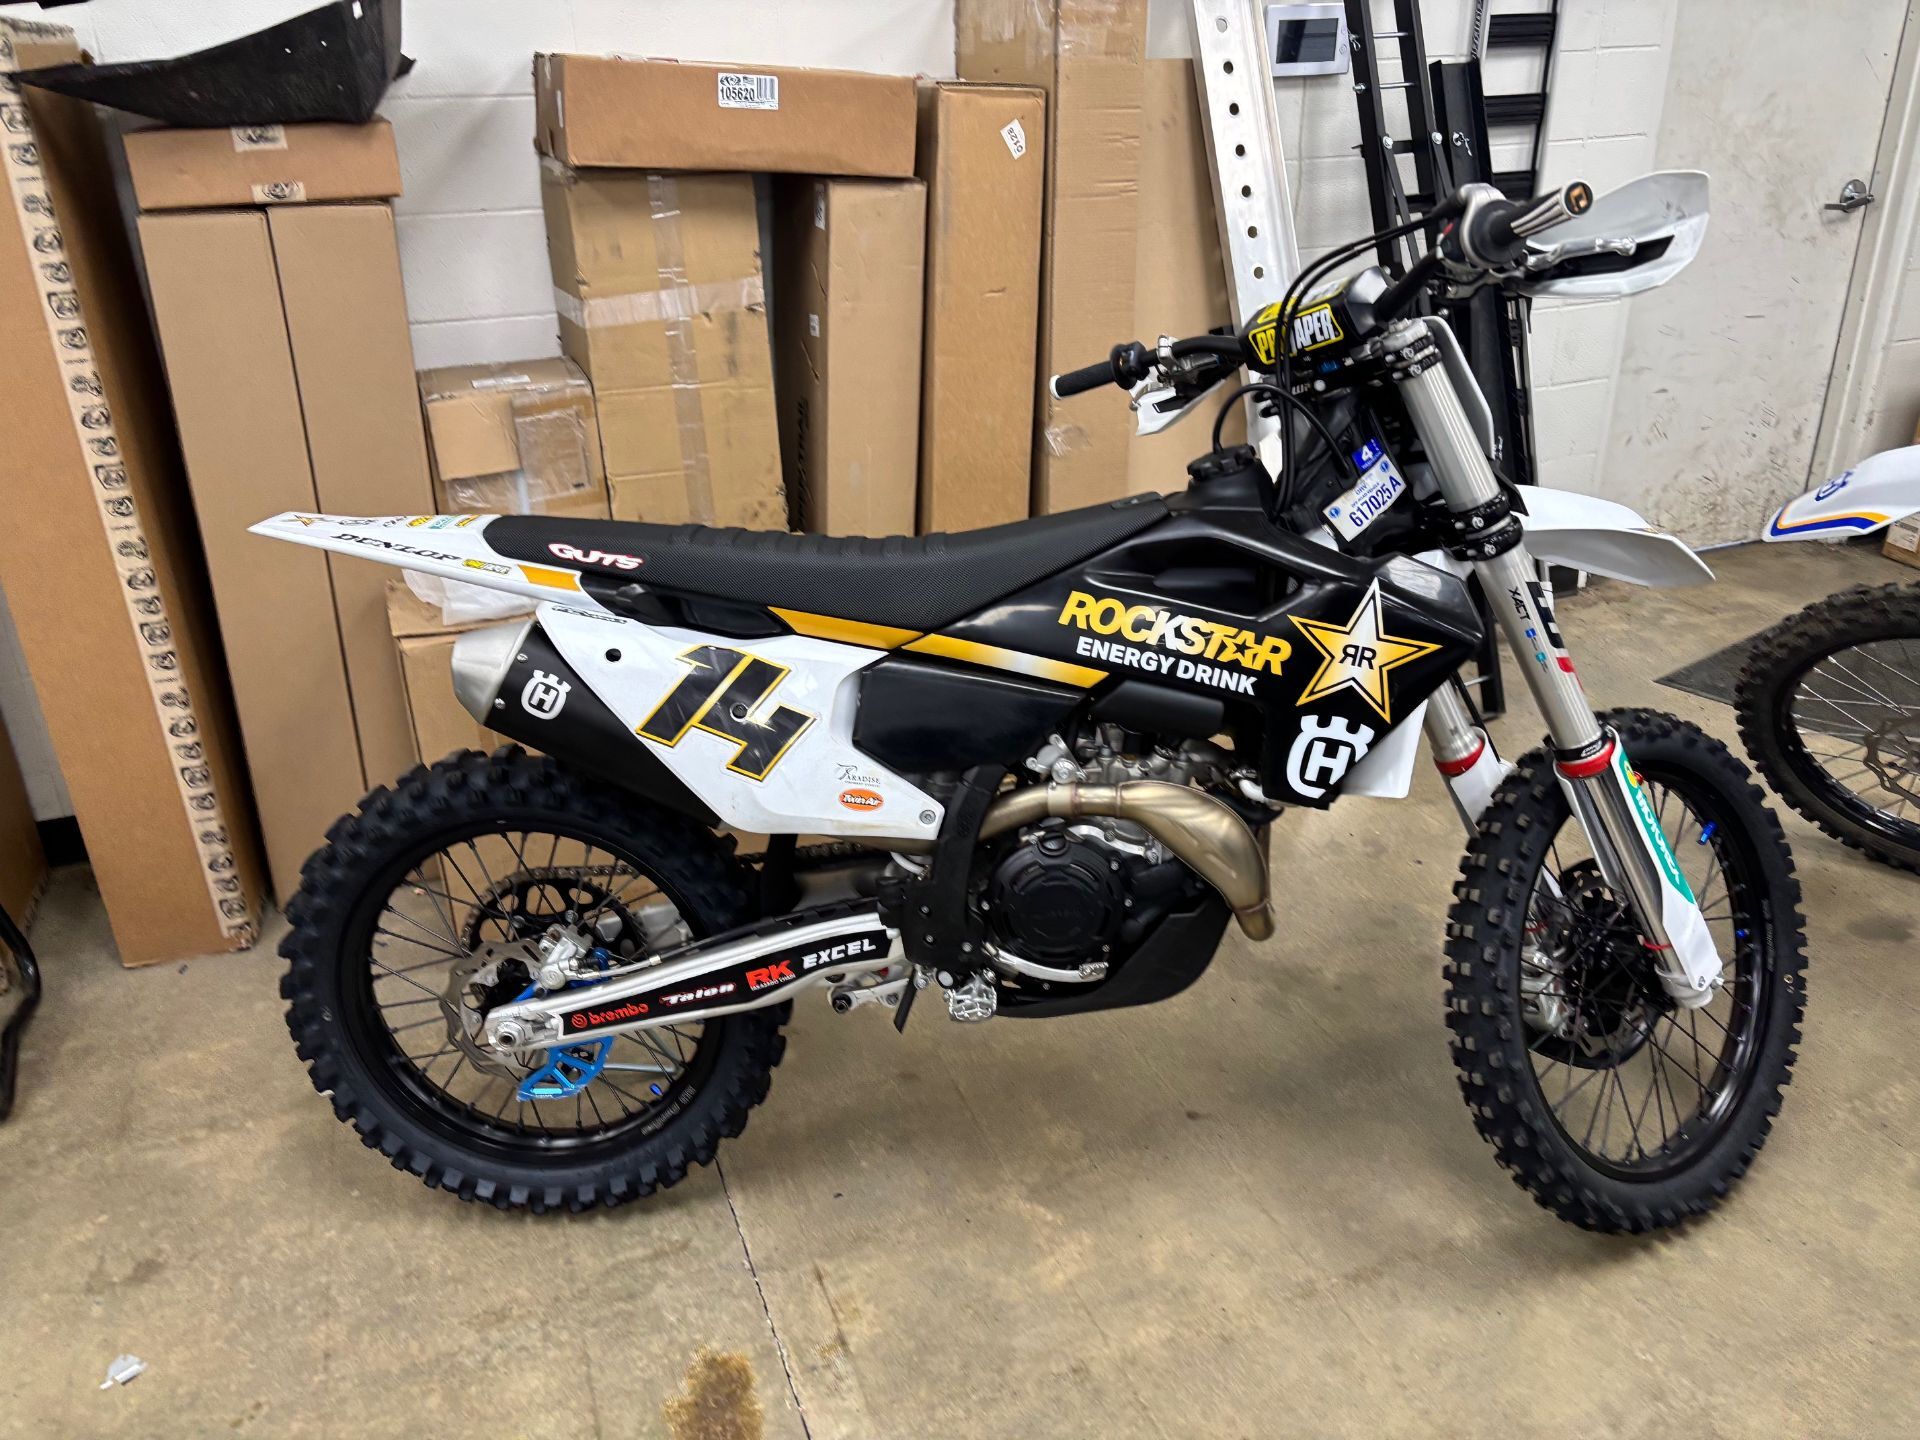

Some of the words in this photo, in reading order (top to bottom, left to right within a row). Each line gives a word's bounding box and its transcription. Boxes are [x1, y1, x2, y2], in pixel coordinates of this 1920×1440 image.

[720, 86, 755, 101] 105620
[1361, 444, 1373, 461] 4
[1348, 483, 1393, 528] 617025
[1388, 475, 1402, 493] A
[329, 533, 462, 561] DUNLOP
[547, 543, 644, 571] GUTS
[1507, 586, 1531, 621] XACT
[1058, 590, 1293, 677] ROCKSTAR
[1075, 635, 1175, 675] ENERGY
[1176, 659, 1259, 697] DRINK
[636, 644, 818, 782] 14
[802, 938, 877, 970] EXCEL
[745, 959, 795, 988] RK
[661, 983, 735, 1005] Talon
[588, 1003, 649, 1025] brembo
